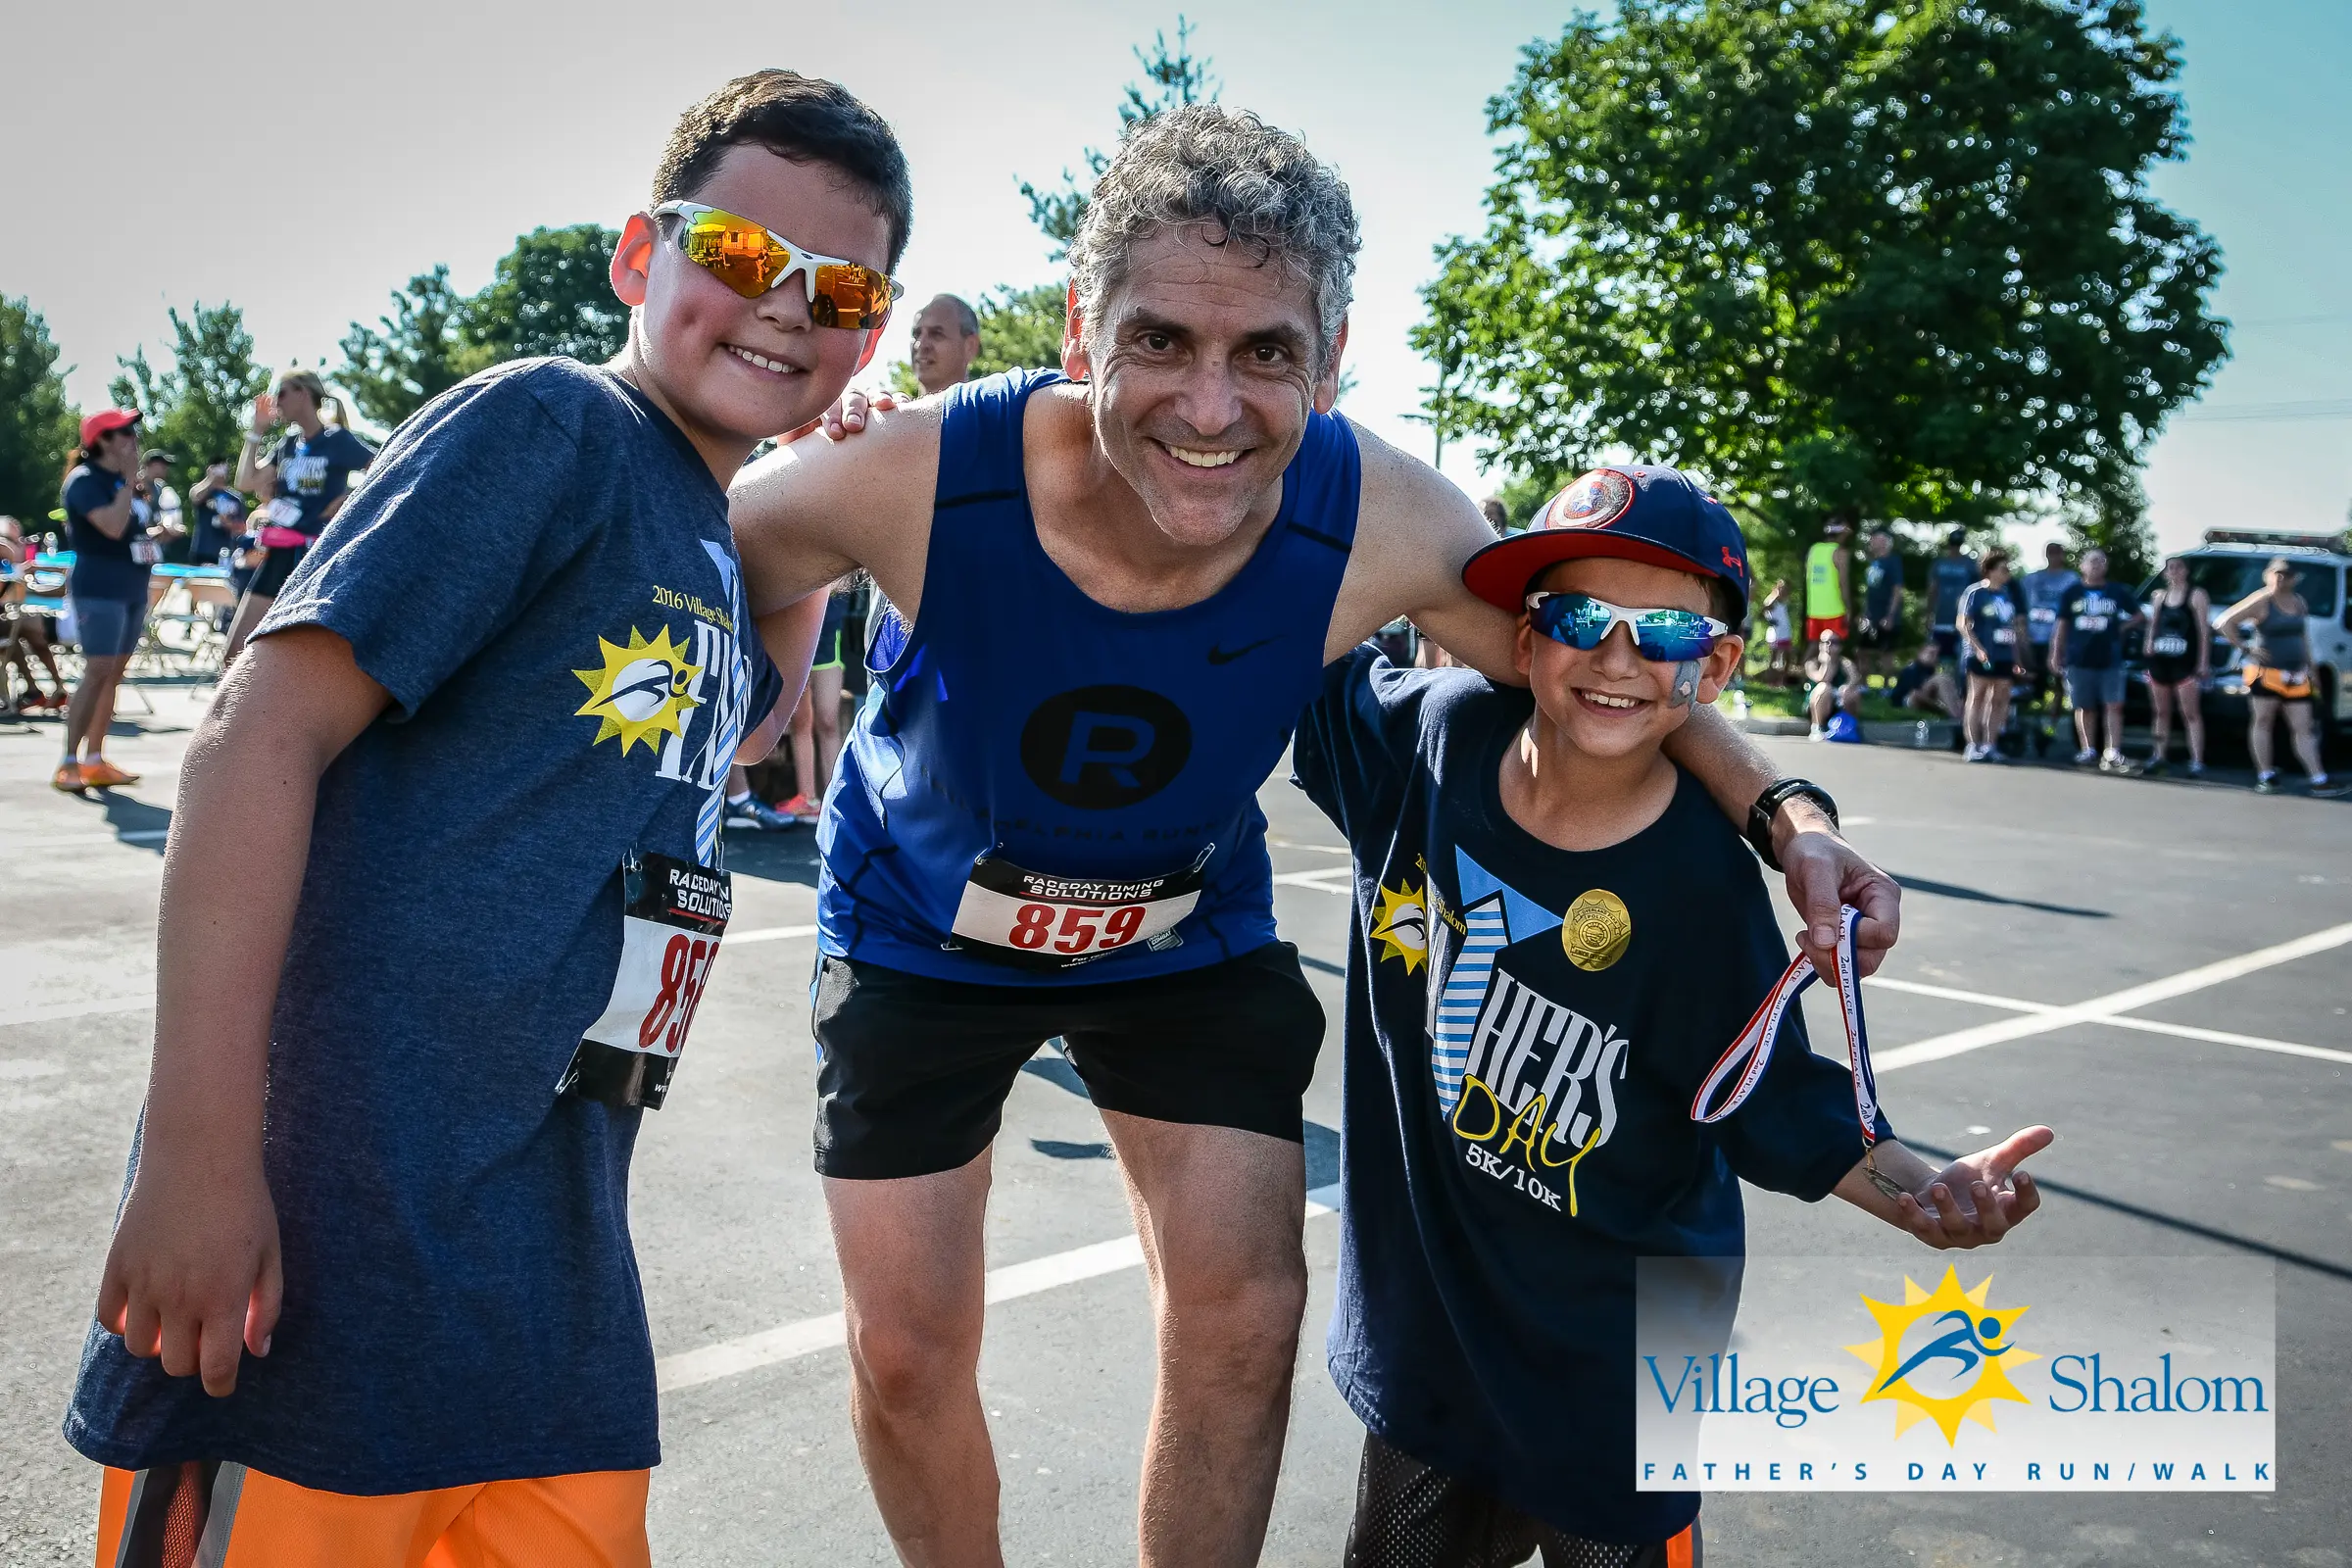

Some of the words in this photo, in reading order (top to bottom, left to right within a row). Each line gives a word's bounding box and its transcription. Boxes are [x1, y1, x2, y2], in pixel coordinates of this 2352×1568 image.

[652, 585, 684, 610] 2016
[683, 593, 716, 624] Village
[1023, 875, 1105, 891] RACEDAY
[1108, 879, 1164, 893] TIMING
[1030, 885, 1152, 901] SOLUTIONS
[1008, 904, 1147, 955] 859
[1840, 956, 1850, 974] 2nd
[1841, 978, 1853, 1015] PLACE
[1452, 1075, 1601, 1216] DAY
[1465, 1142, 1562, 1212] 5K/10K
